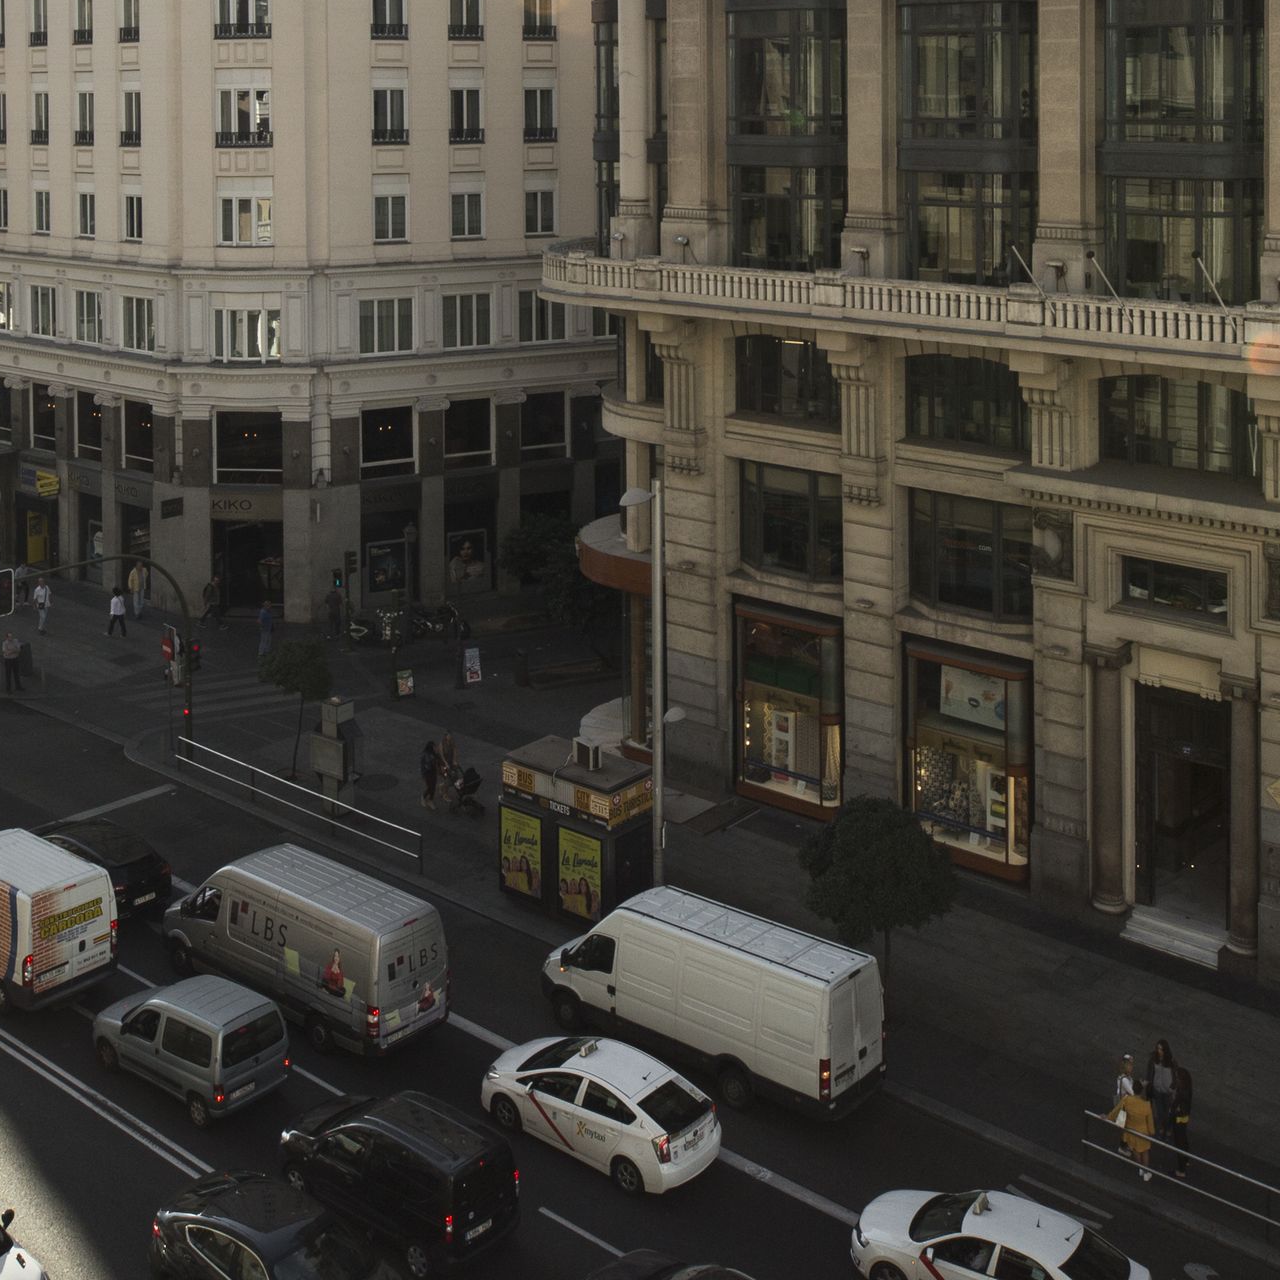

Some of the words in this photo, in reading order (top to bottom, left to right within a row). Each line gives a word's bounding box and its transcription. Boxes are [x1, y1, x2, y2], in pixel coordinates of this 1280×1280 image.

[212, 499, 253, 511] KIKO
[517, 769, 533, 785] BUS
[577, 789, 591, 800] CITY
[549, 800, 570, 816] TICKETS
[39, 906, 103, 939] CARCOBA
[251, 910, 288, 947] LBS
[408, 942, 438, 972] LBS
[585, 1127, 606, 1143] mytaxi
